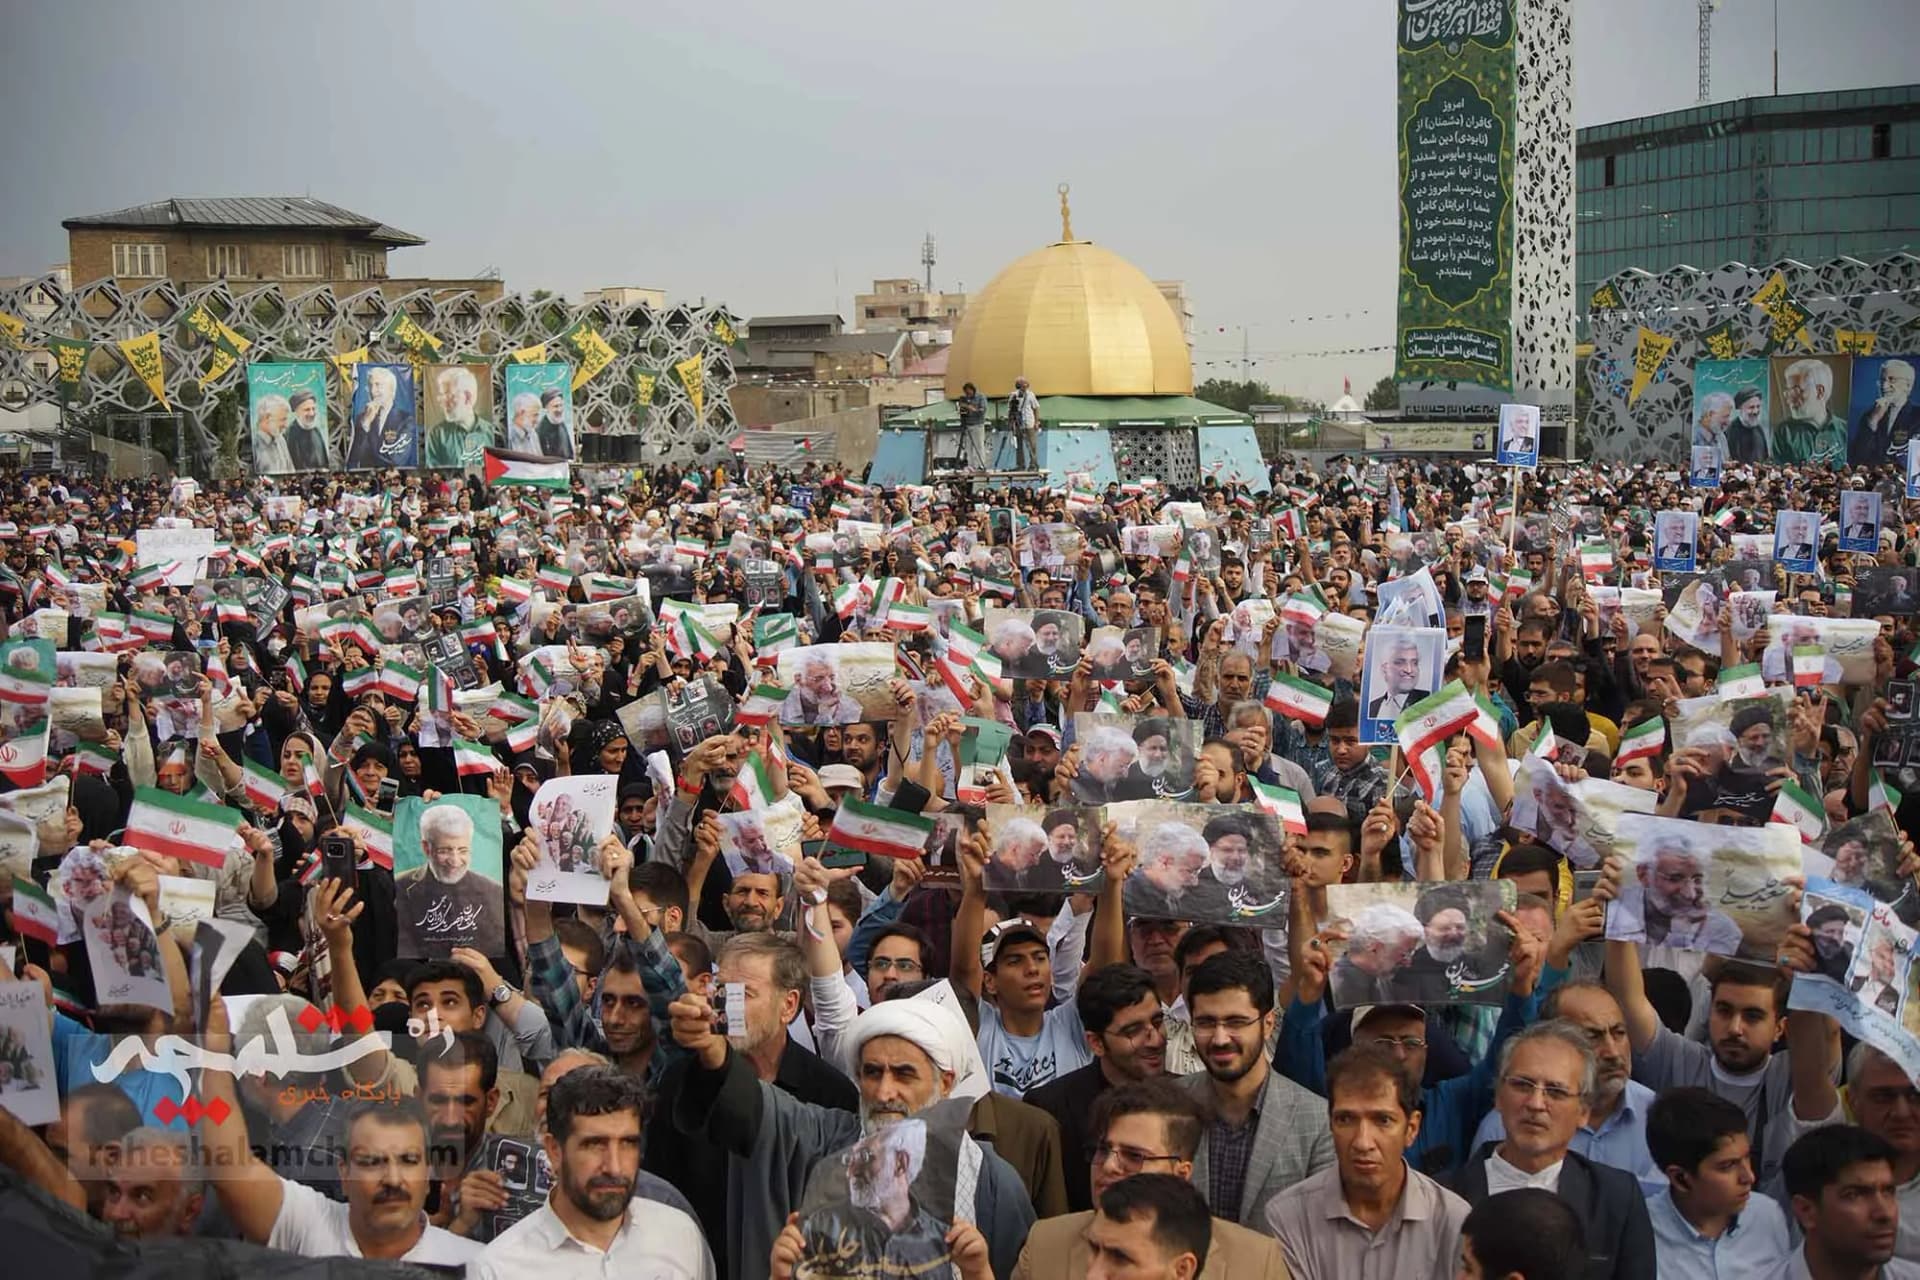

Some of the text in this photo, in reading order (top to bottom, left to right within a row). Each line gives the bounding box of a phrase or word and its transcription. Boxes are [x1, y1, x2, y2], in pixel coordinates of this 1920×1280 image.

[1442, 97, 1465, 112] امروز
[1416, 119, 1423, 132] از
[1465, 115, 1492, 129] کافران
[1420, 133, 1436, 145] شما
[1439, 135, 1453, 146] دین
[1467, 152, 1472, 161] و
[1473, 152, 1496, 163] ناامید
[1410, 169, 1417, 182] از
[1421, 171, 1426, 181] و
[1473, 168, 1481, 180] از
[1483, 174, 1497, 184] پس
[1412, 187, 1427, 198] دین
[1428, 182, 1450, 196] امروز
[1483, 190, 1496, 199] من
[1417, 200, 1438, 214] کامل
[1466, 199, 1472, 212] را
[1473, 200, 1490, 213] شما
[1415, 216, 1493, 232] کردم و نعمت خود را
[1416, 238, 1421, 247] و
[1421, 233, 1447, 247] نمودم
[1448, 232, 1465, 246] تمام
[1412, 248, 1494, 266] دین اسلام را برای شما
[1408, 344, 1438, 357] ایمان
[1439, 344, 1463, 357] اهل
